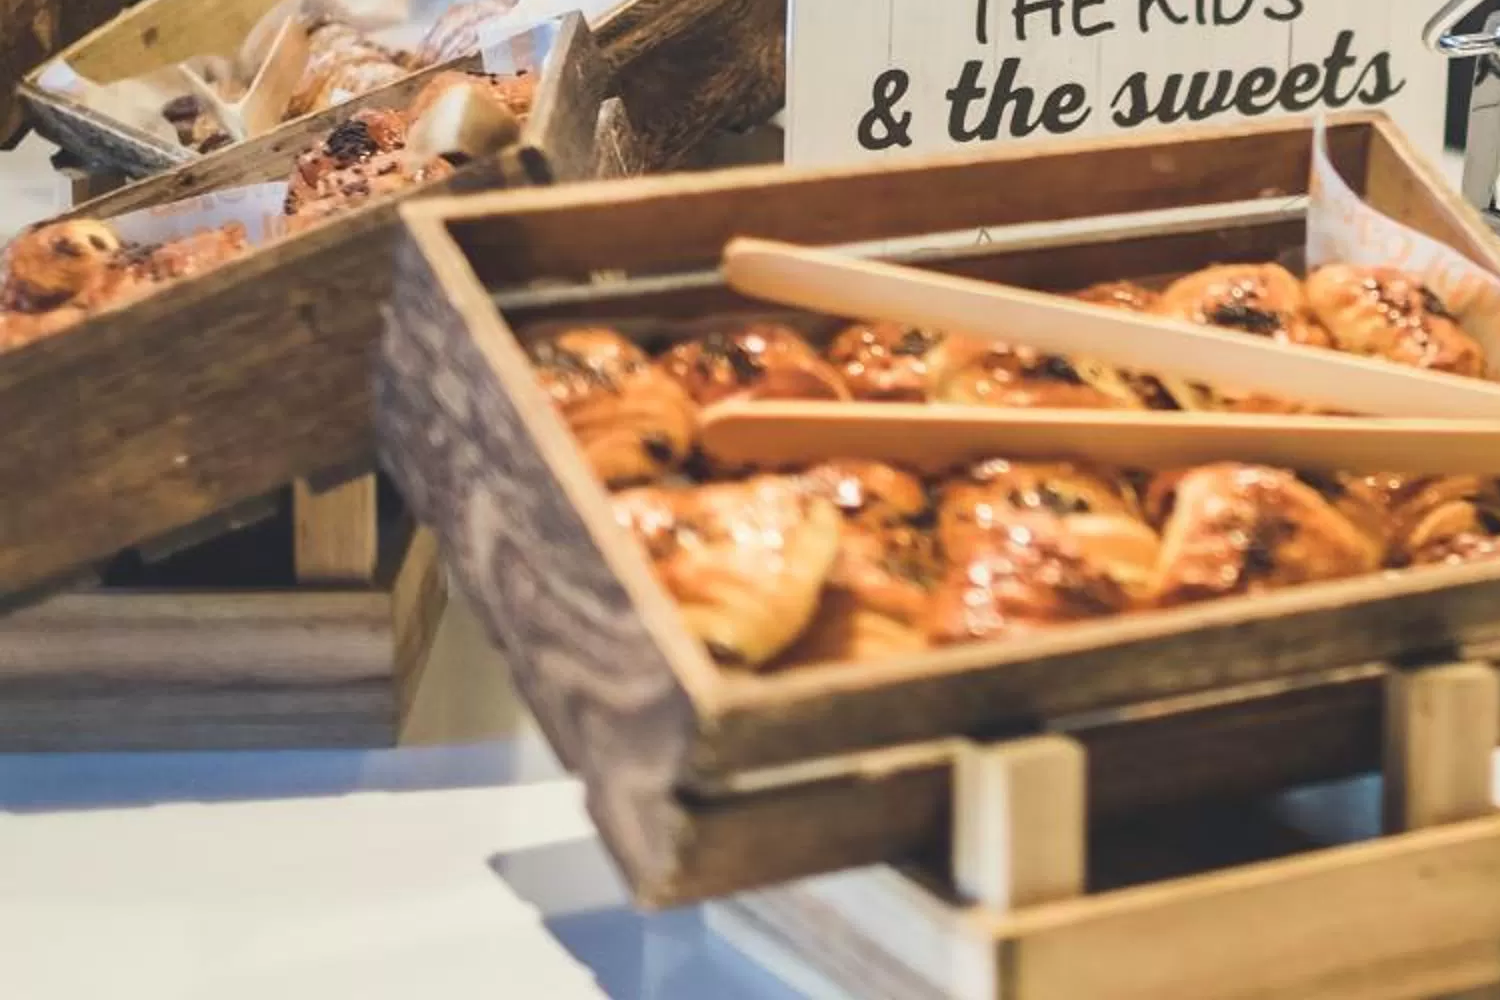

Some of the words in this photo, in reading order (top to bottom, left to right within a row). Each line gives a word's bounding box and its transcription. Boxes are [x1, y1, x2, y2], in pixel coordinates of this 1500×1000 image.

[856, 68, 914, 152] &
[944, 56, 1092, 144] the
[1109, 29, 1407, 128] sweets
